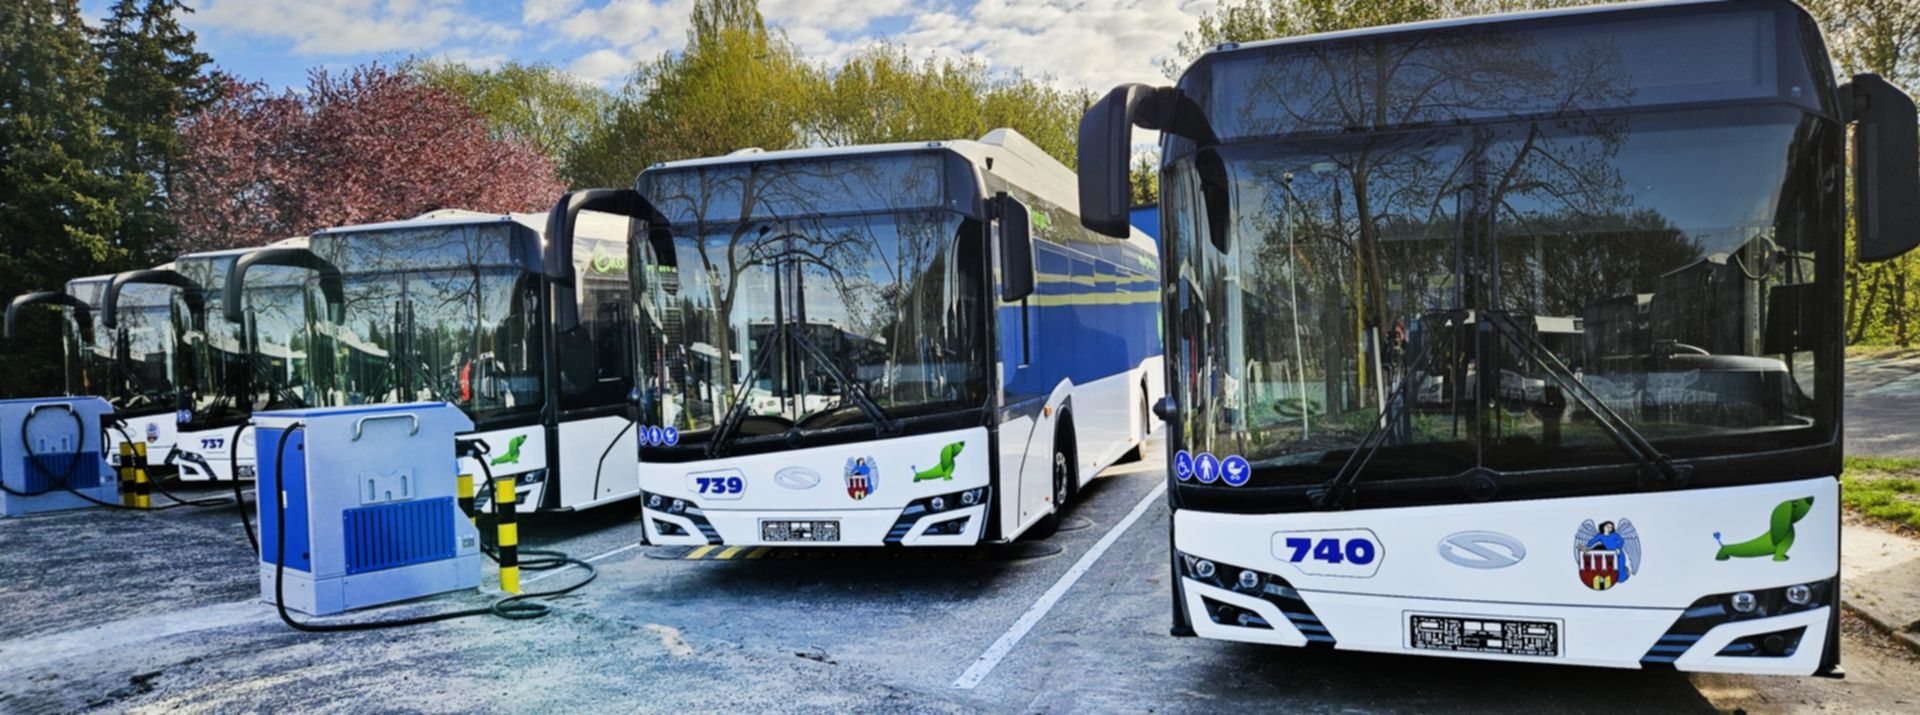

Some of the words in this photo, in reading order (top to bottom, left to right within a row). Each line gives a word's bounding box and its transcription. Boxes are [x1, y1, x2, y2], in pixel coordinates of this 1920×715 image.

[201, 438, 224, 449] 737
[696, 476, 743, 494] 739
[1286, 537, 1375, 566] 740
